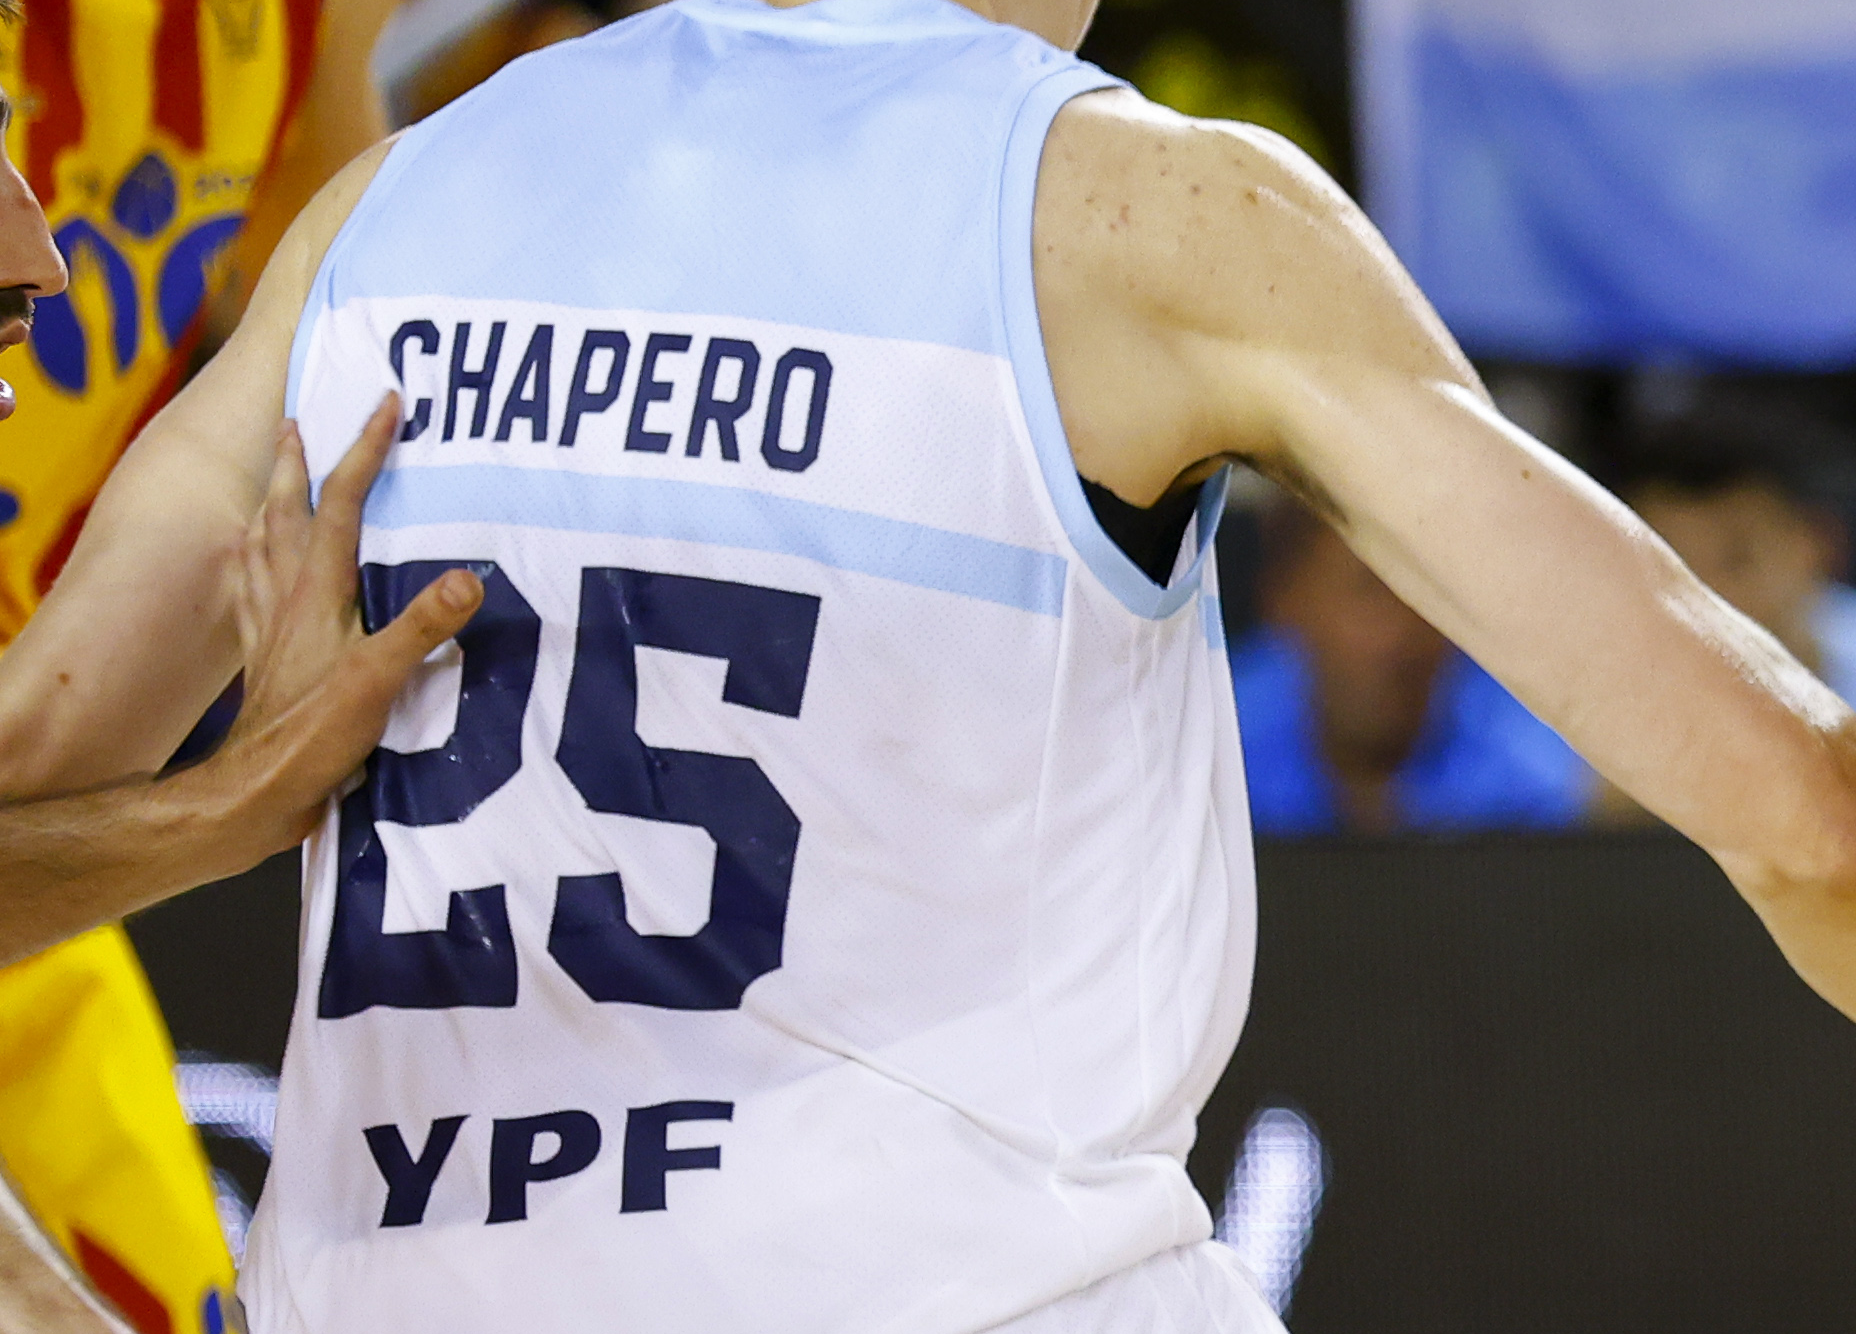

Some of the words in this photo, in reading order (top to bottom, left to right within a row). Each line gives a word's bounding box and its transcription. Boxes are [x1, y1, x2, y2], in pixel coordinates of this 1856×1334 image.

[387, 319, 834, 474] CHAPERO
[318, 559, 821, 1019] 25
[363, 1100, 734, 1228] YPF
